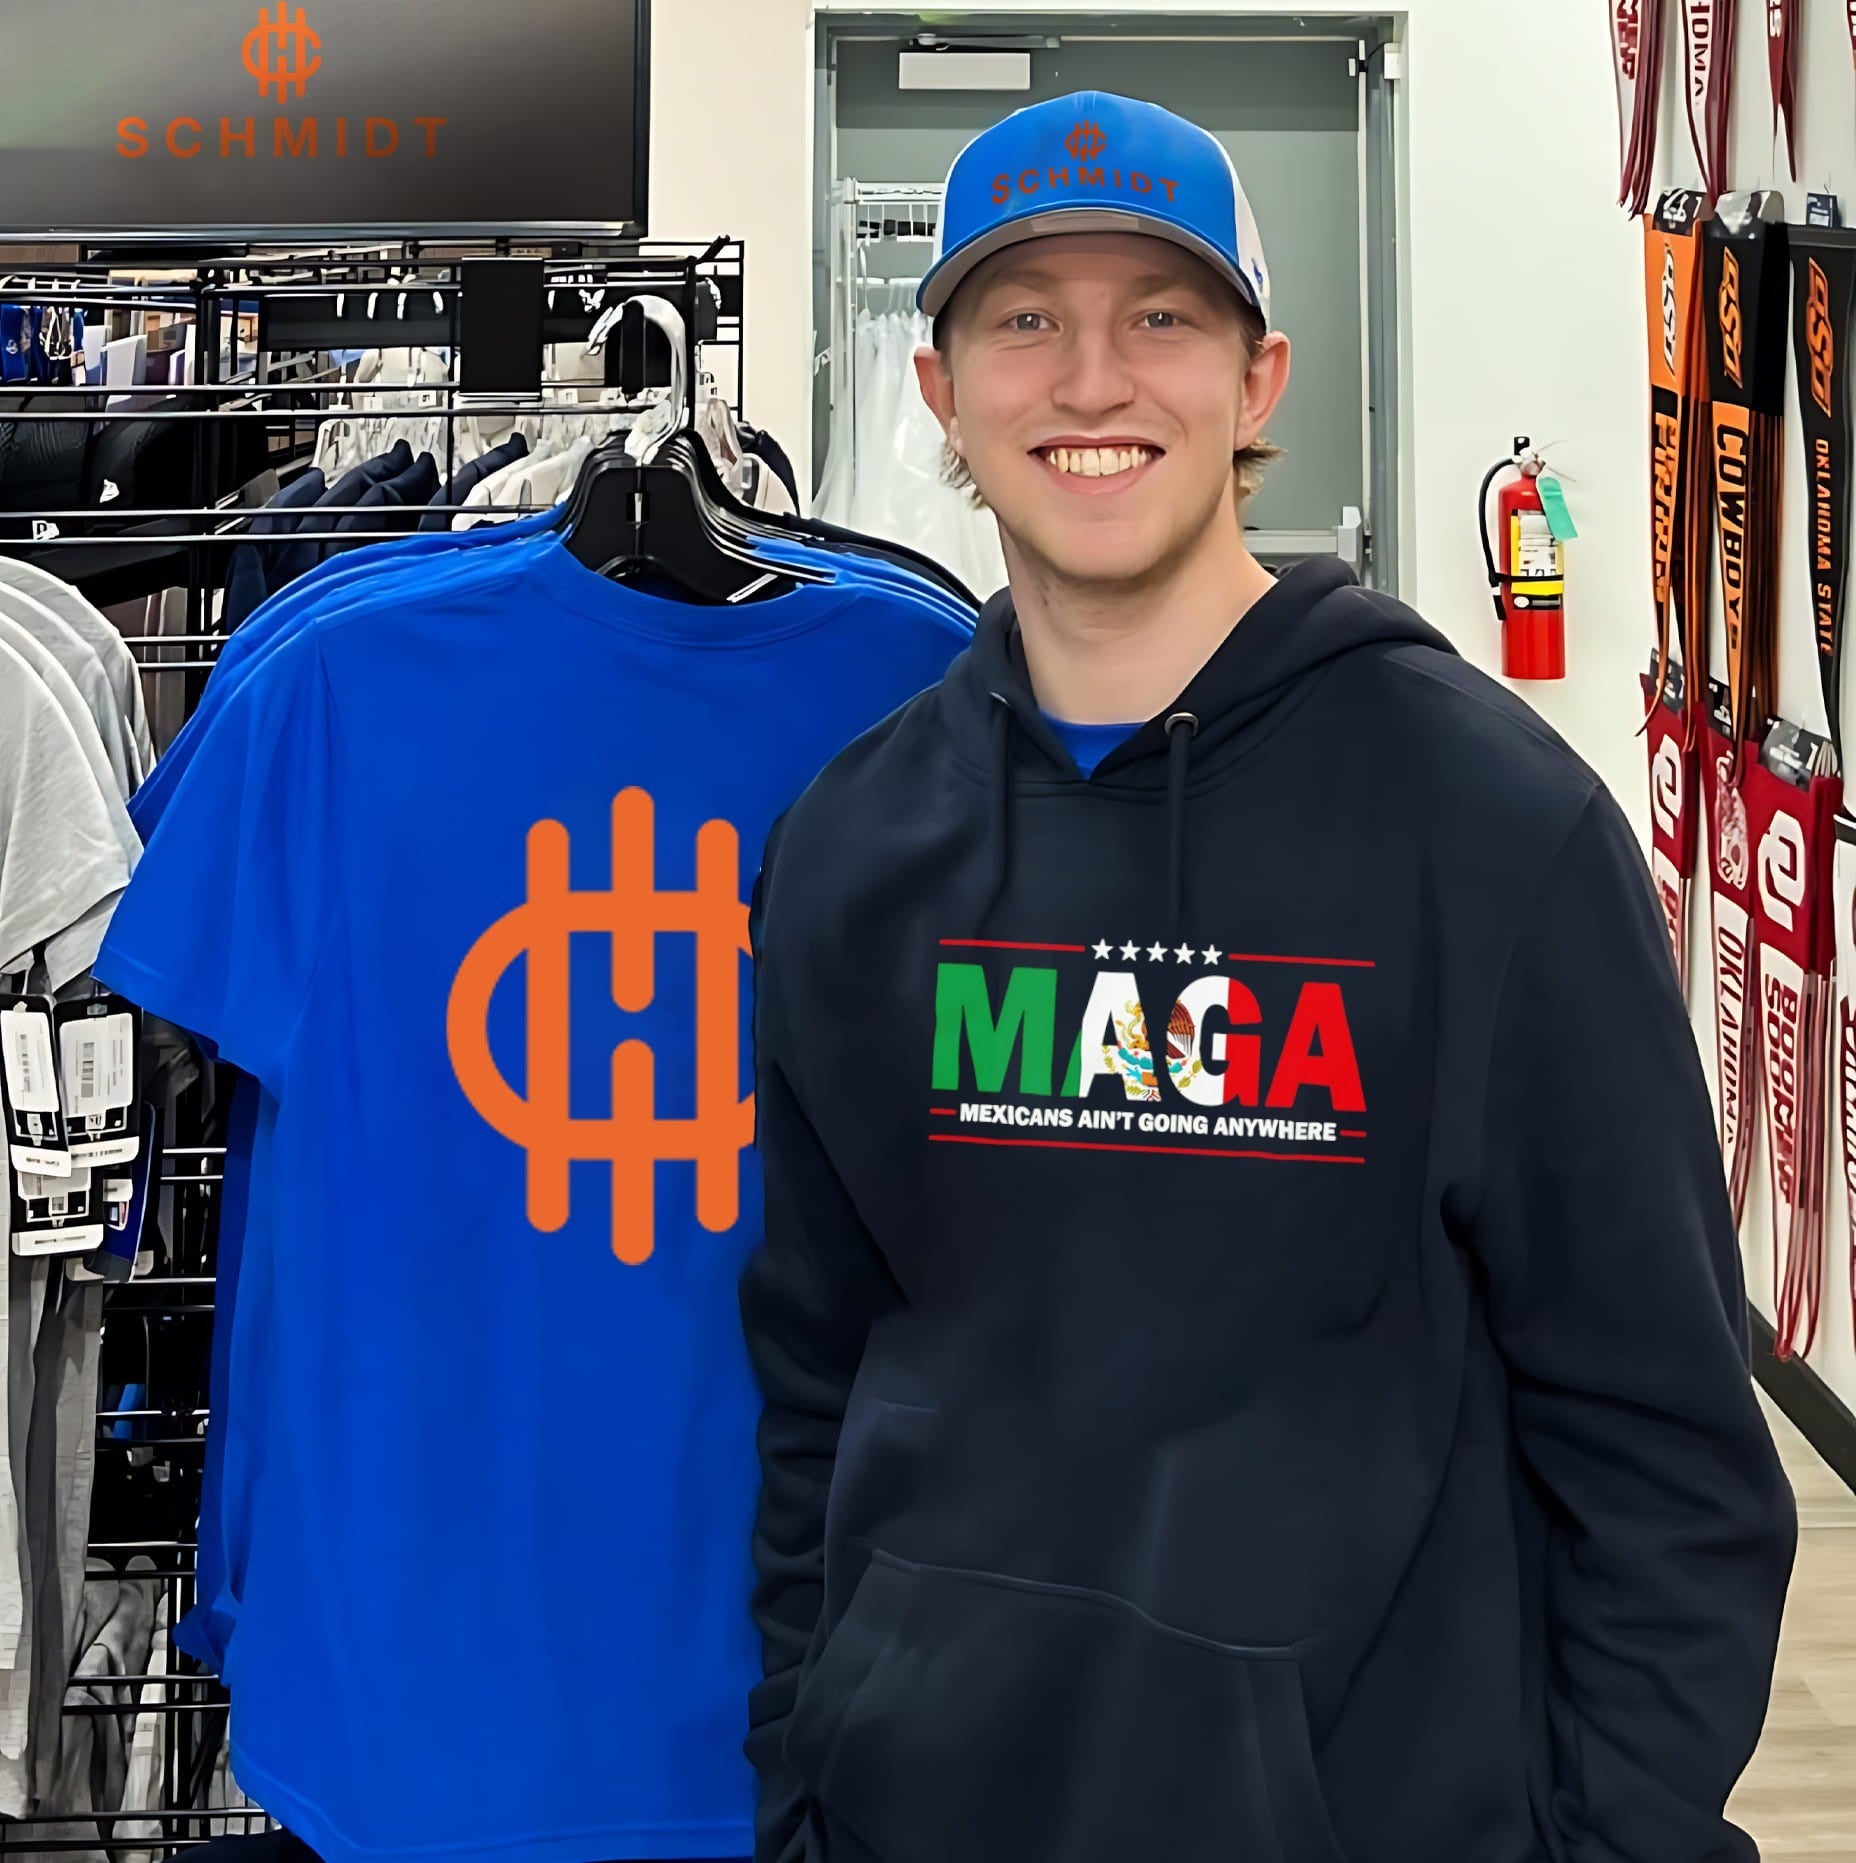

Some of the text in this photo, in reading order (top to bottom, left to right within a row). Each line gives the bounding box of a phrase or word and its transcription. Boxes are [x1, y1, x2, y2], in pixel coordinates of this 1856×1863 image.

[116, 116, 447, 159] SCHMIDT
[991, 167, 1179, 205] SCHMIDT
[1815, 438, 1832, 570] OKLAHOMA
[932, 962, 1367, 1113] MAGA
[960, 1103, 1337, 1142] MEXICANS AIN'T GOING ANYWHERE
